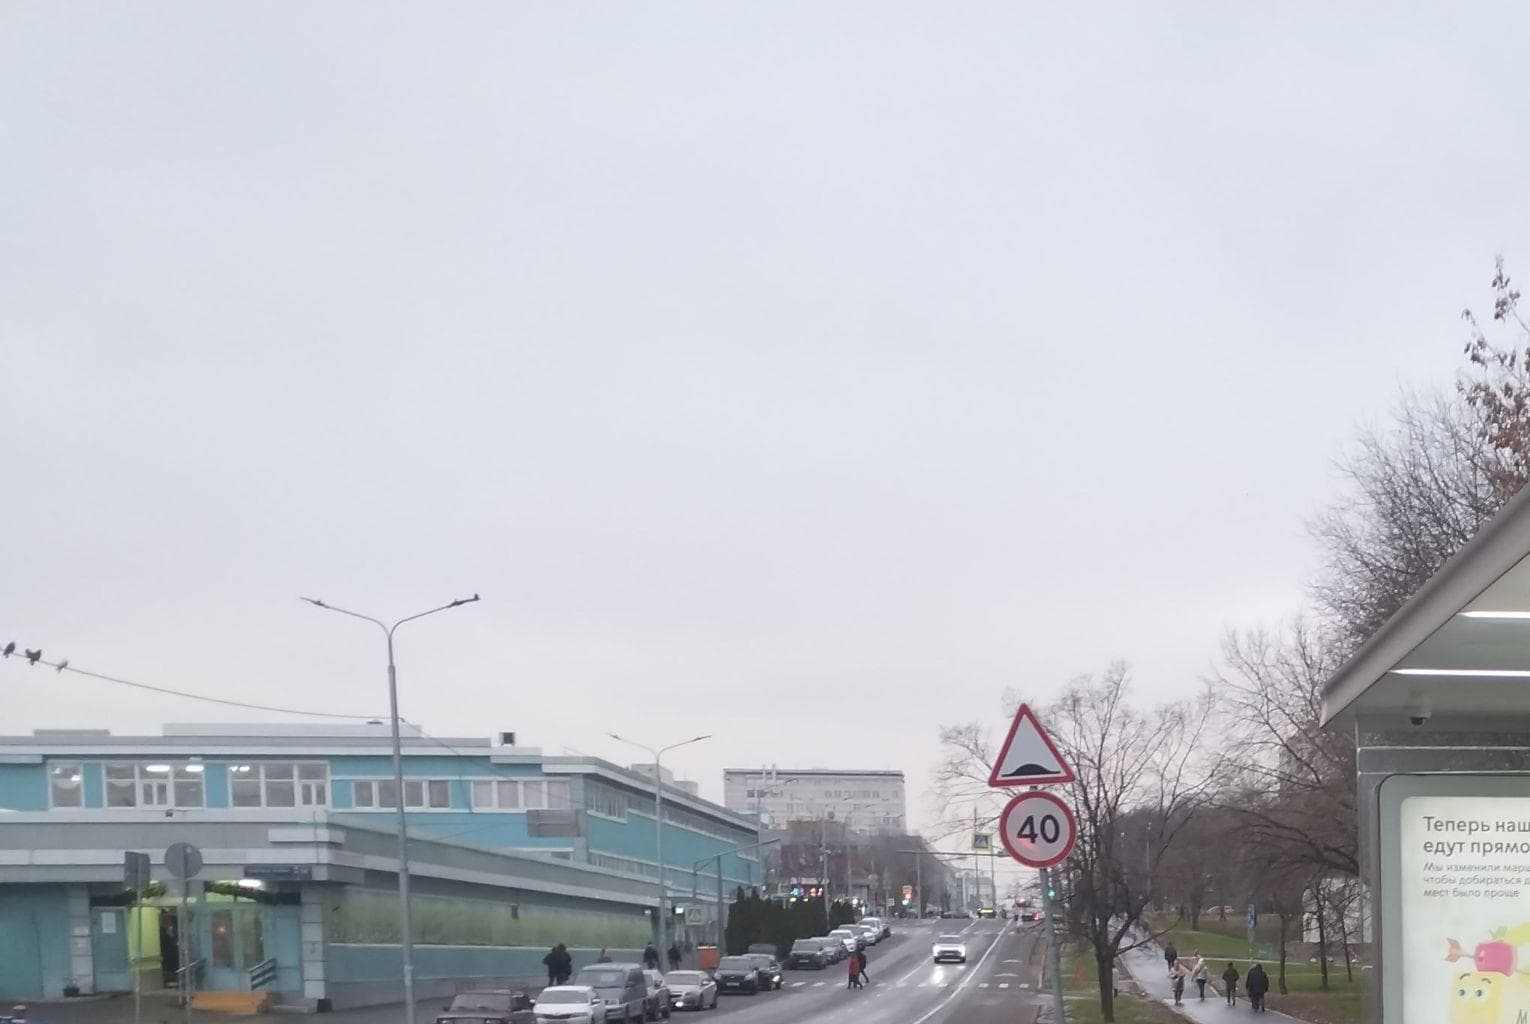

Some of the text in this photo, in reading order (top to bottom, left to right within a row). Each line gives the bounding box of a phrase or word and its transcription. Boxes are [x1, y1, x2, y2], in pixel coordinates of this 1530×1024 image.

[1017, 814, 1060, 844] 40
[1423, 816, 1490, 836] Теперь
[1423, 841, 1465, 857] едут
[1471, 841, 1530, 857] прямо
[1423, 863, 1443, 872] Мы
[1447, 863, 1500, 872] изменили
[1423, 875, 1456, 885] чтобы
[1459, 875, 1521, 886] добираться
[1423, 888, 1519, 899] мест было проще
